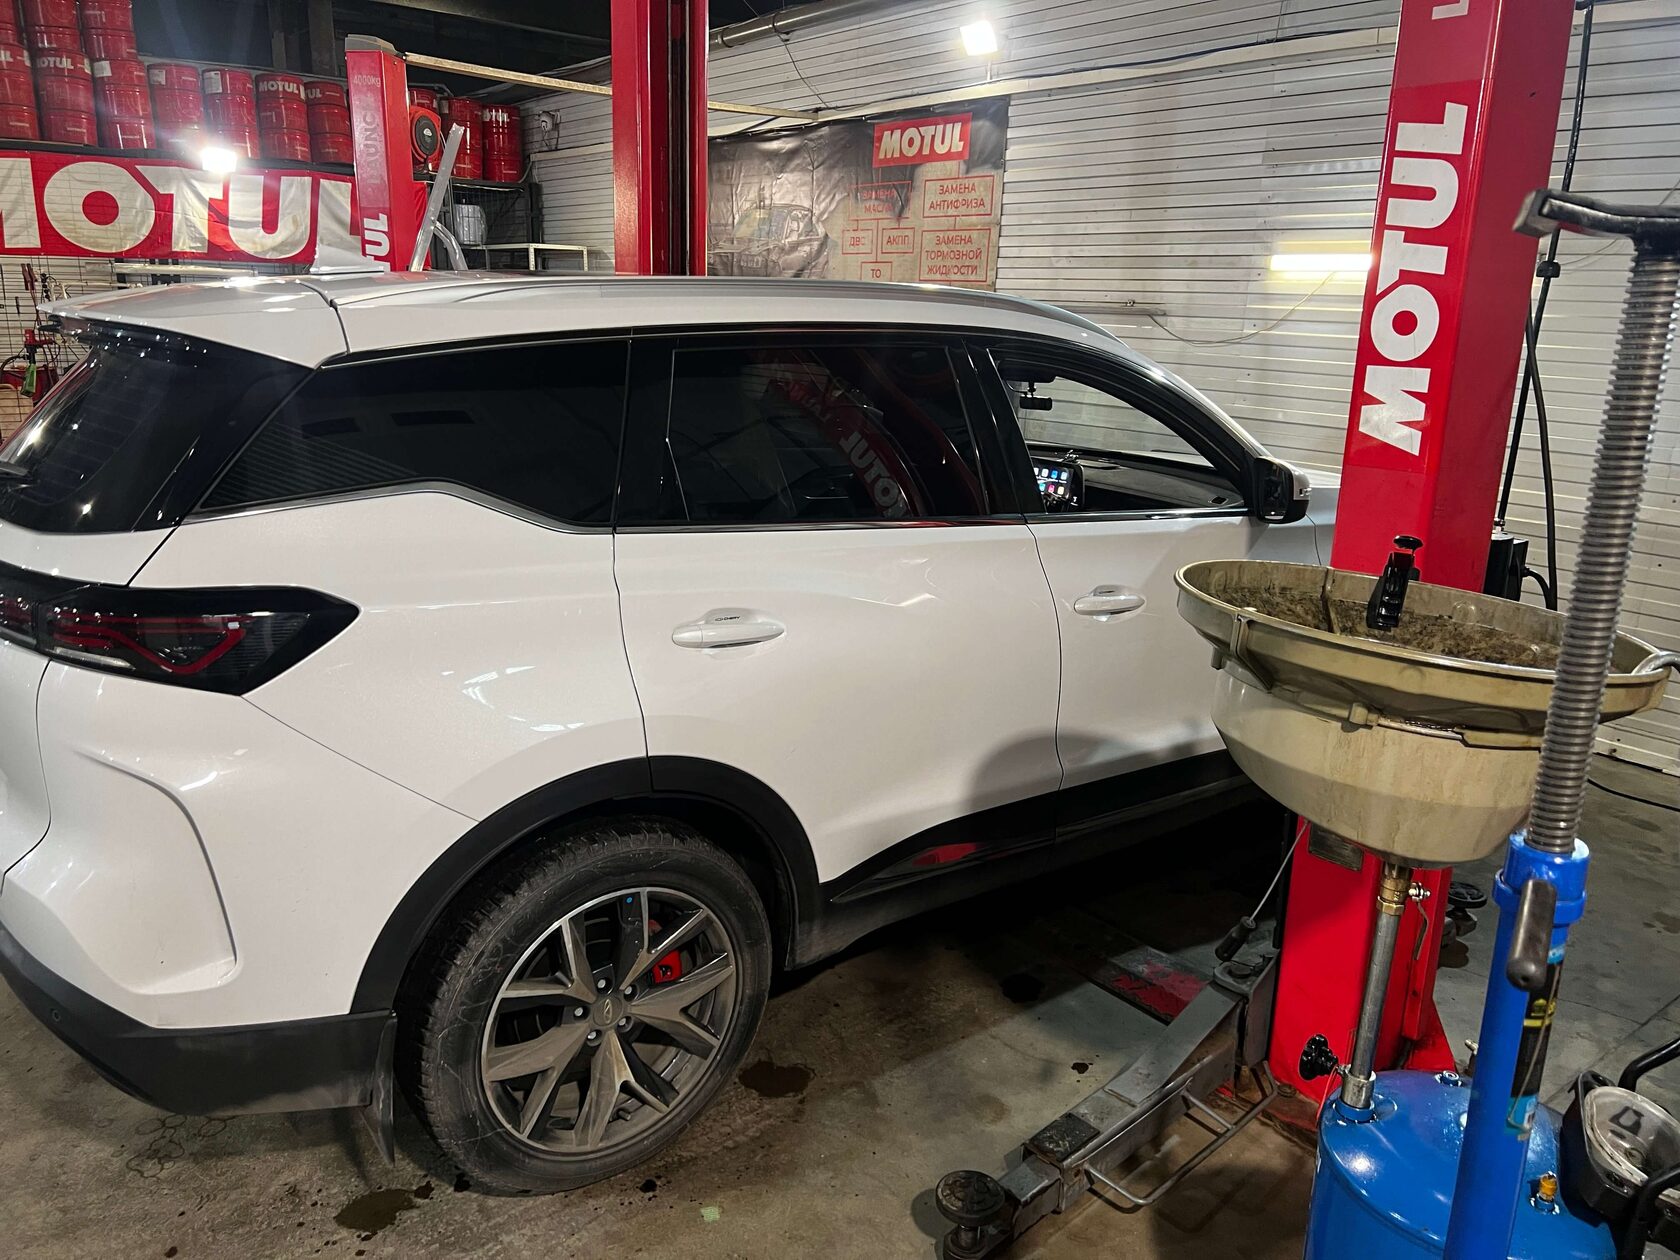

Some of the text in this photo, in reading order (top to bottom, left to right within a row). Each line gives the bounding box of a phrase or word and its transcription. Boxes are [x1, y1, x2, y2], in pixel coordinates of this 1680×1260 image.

[259, 81, 299, 94] MOTUL
[879, 122, 964, 159] MOTUL
[938, 182, 977, 195] ЗАМЕНА
[928, 198, 986, 211] АНТИФРИЗА
[886, 235, 911, 246] АКПП
[935, 234, 973, 246] ЗАМЕНА
[926, 247, 982, 260] ТОРМОЗНОЙ
[871, 268, 882, 279] ТО
[927, 264, 978, 276] ЖИДКОСТИ
[1358, 101, 1468, 456] MOTUL
